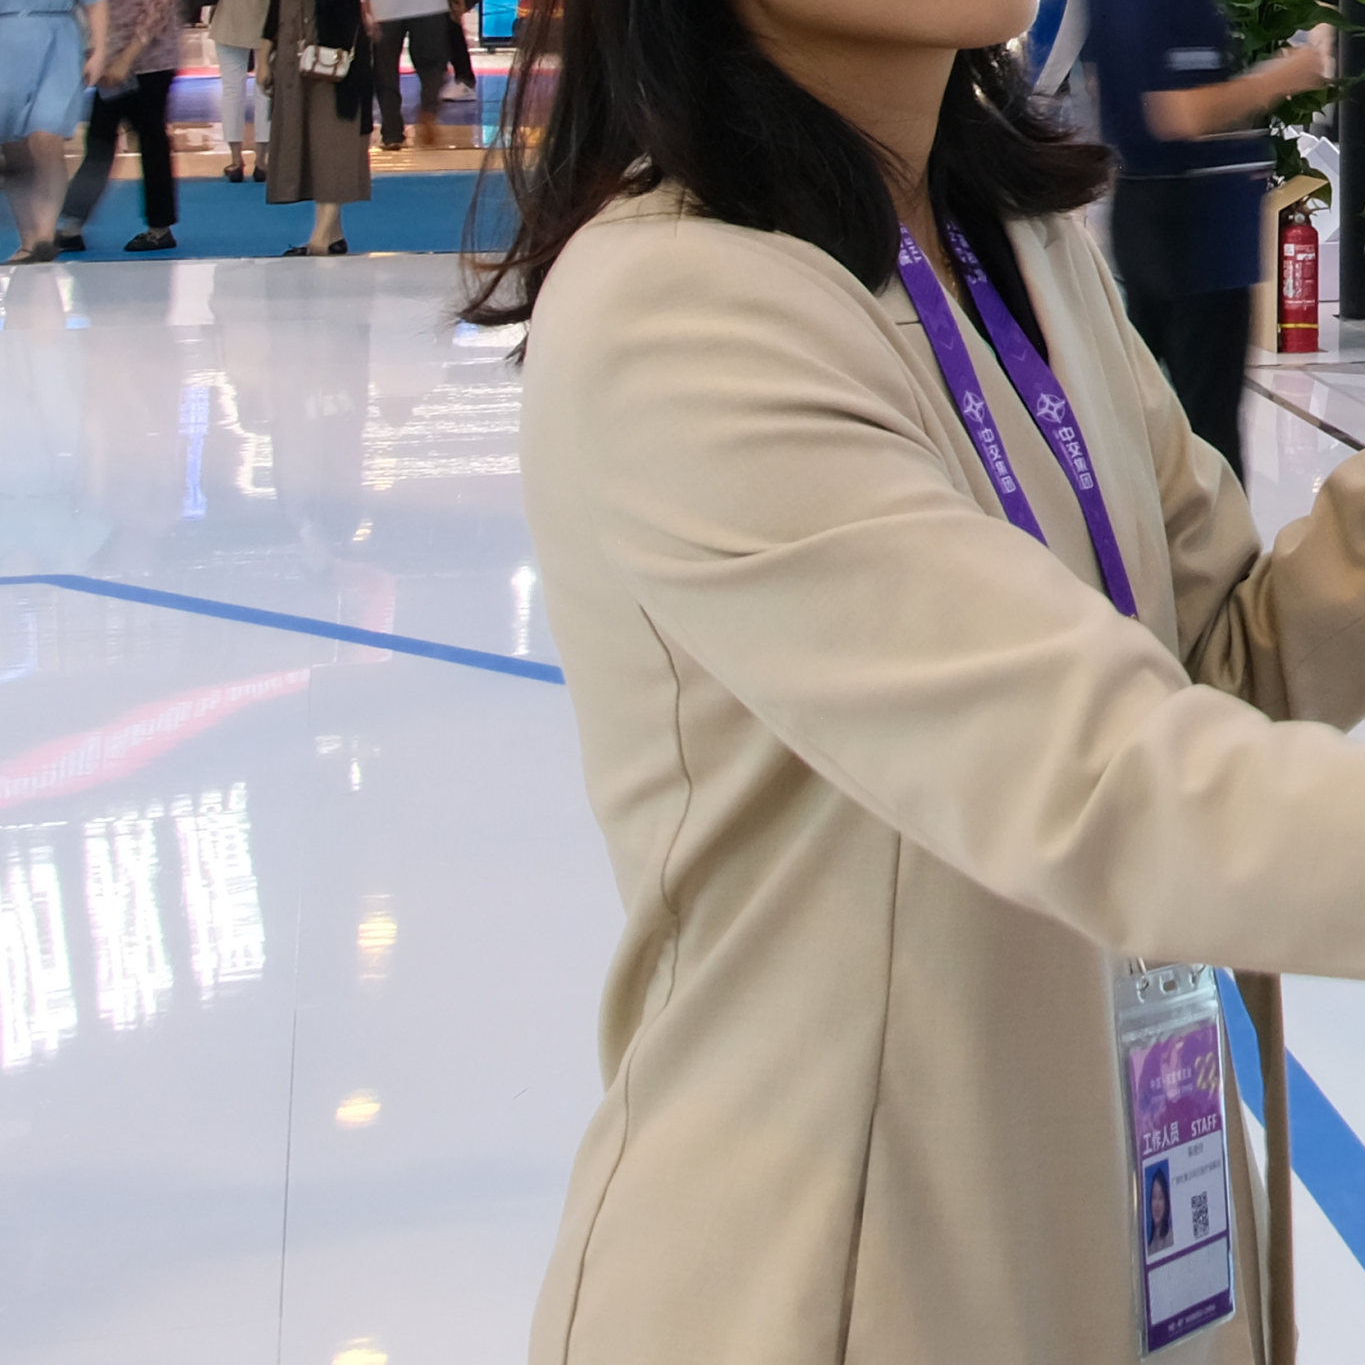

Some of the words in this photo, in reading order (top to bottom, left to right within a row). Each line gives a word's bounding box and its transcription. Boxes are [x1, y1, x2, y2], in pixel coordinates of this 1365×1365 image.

[1142, 1120, 1180, 1156] 工作人员
[1190, 1113, 1219, 1138] STAFF
